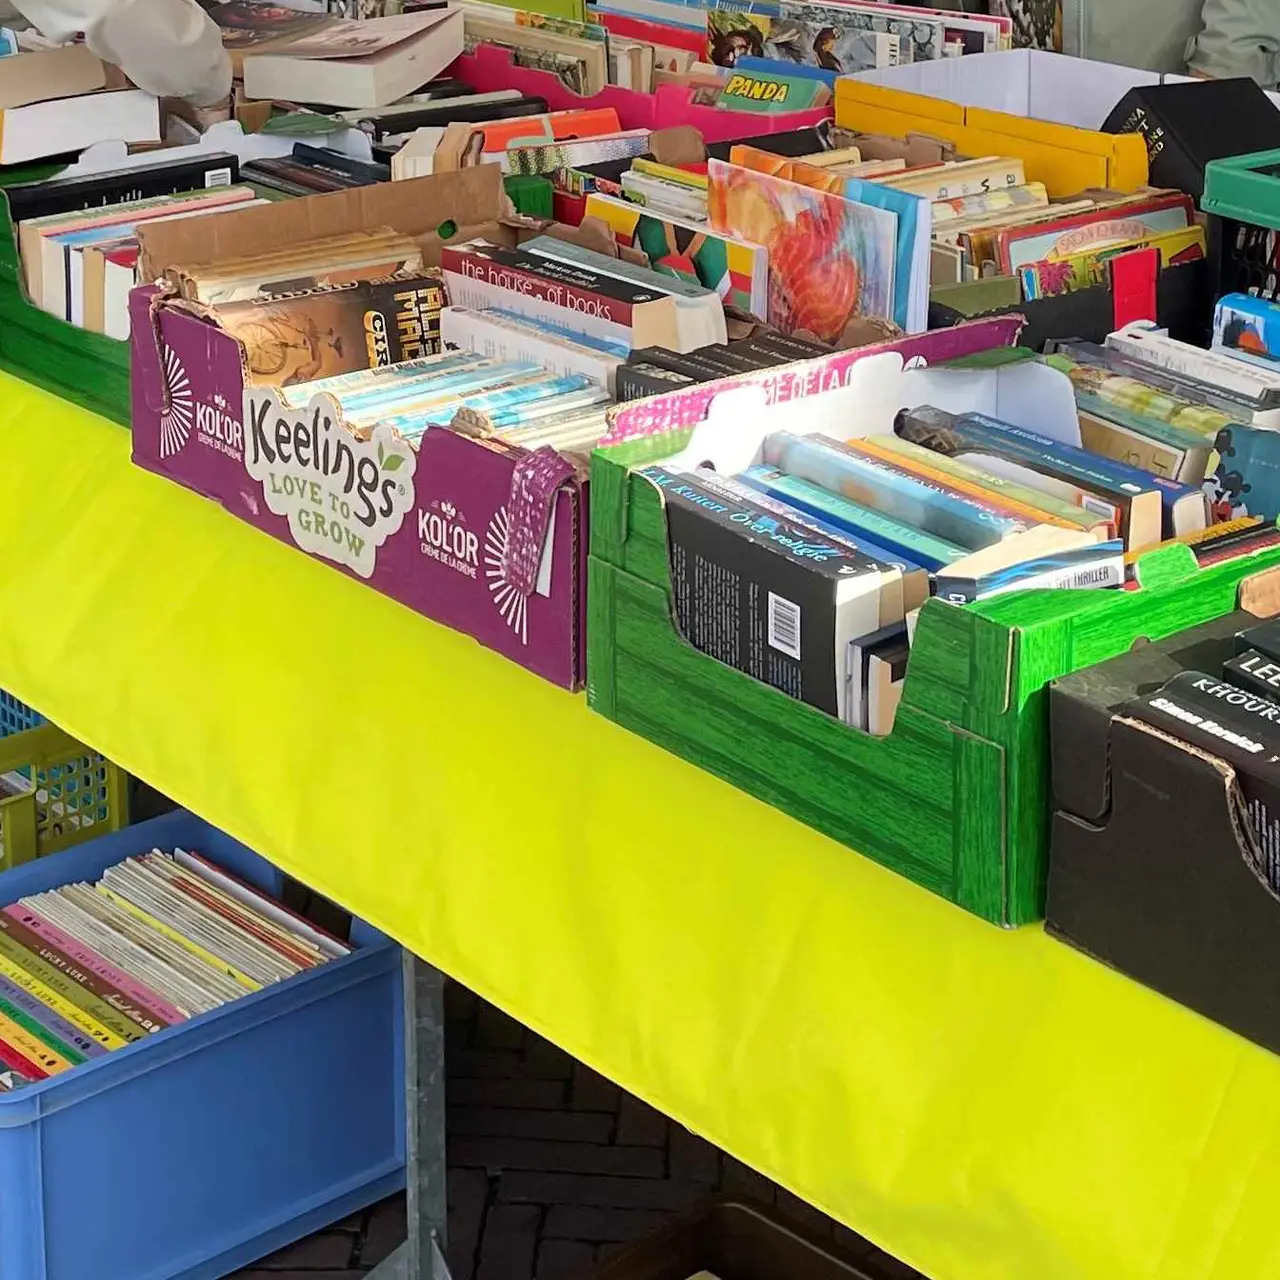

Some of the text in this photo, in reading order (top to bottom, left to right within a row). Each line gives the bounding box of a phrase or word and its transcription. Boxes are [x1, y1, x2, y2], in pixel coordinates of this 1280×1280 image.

[725, 75, 790, 104] PANDA
[461, 259, 612, 321] the house of books
[250, 398, 396, 528] Keelings
[269, 472, 350, 520] LOVE TO
[298, 507, 366, 558] GROW
[729, 512, 770, 536] Over
[772, 526, 829, 564] religie
[1073, 567, 1110, 587] THRILLER
[1148, 697, 1202, 727] Simon
